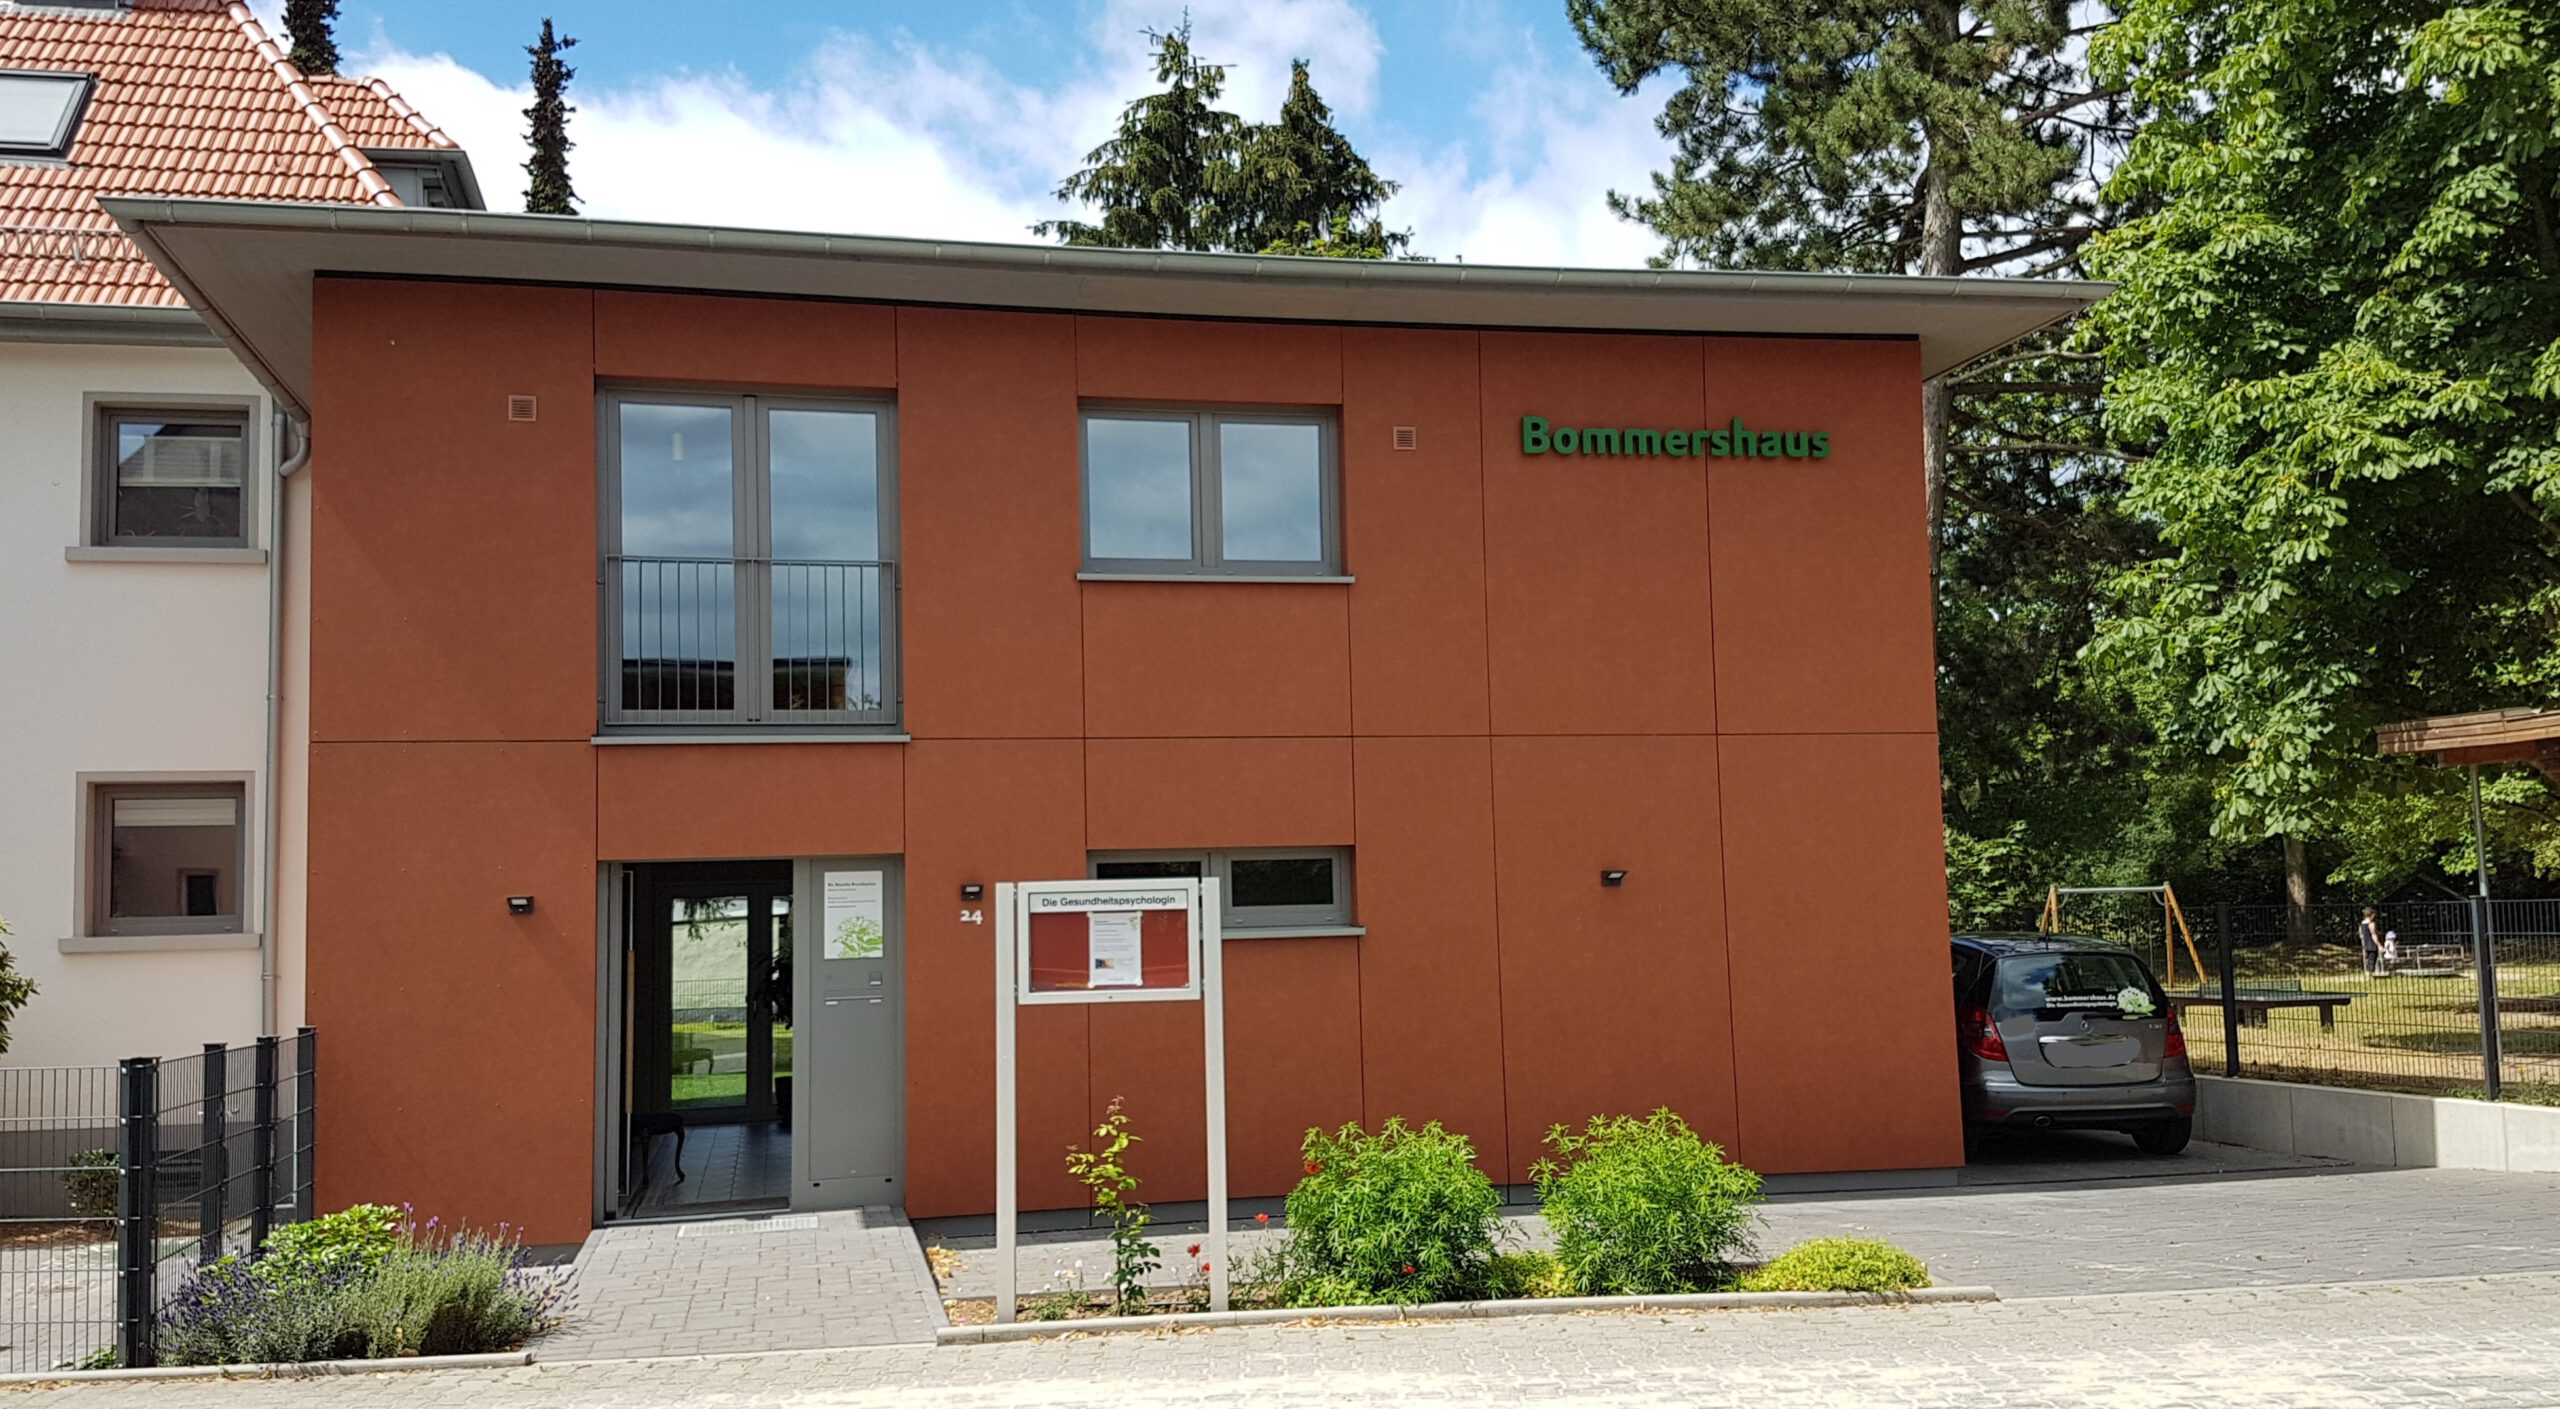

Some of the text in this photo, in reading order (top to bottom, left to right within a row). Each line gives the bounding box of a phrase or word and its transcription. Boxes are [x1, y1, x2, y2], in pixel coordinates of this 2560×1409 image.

[1521, 415, 1832, 459] Bommershaus
[1042, 895, 1176, 908] Die Gesundheitspsychologin
[960, 909, 983, 925] 24
